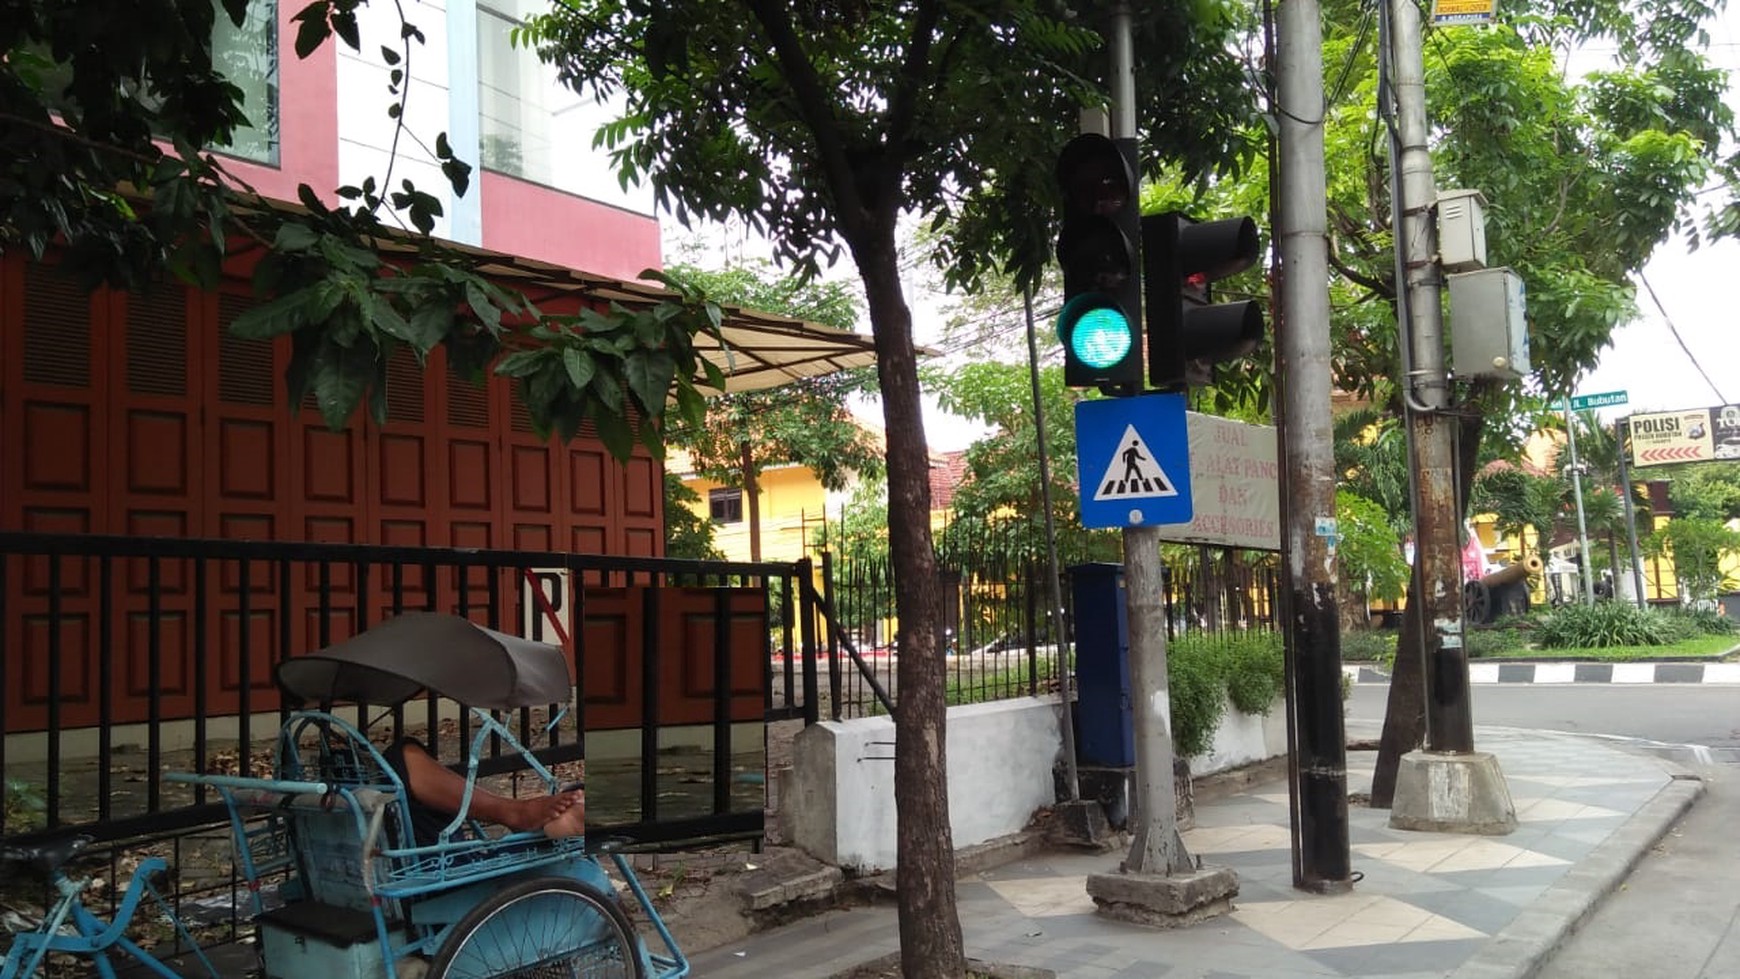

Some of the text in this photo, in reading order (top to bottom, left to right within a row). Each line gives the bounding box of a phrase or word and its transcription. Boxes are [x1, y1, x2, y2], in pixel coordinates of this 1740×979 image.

[1214, 424, 1248, 447] JUAL
[1633, 417, 1680, 434] POLISI
[1206, 452, 1240, 475] ALAT
[1218, 483, 1248, 505] DAN
